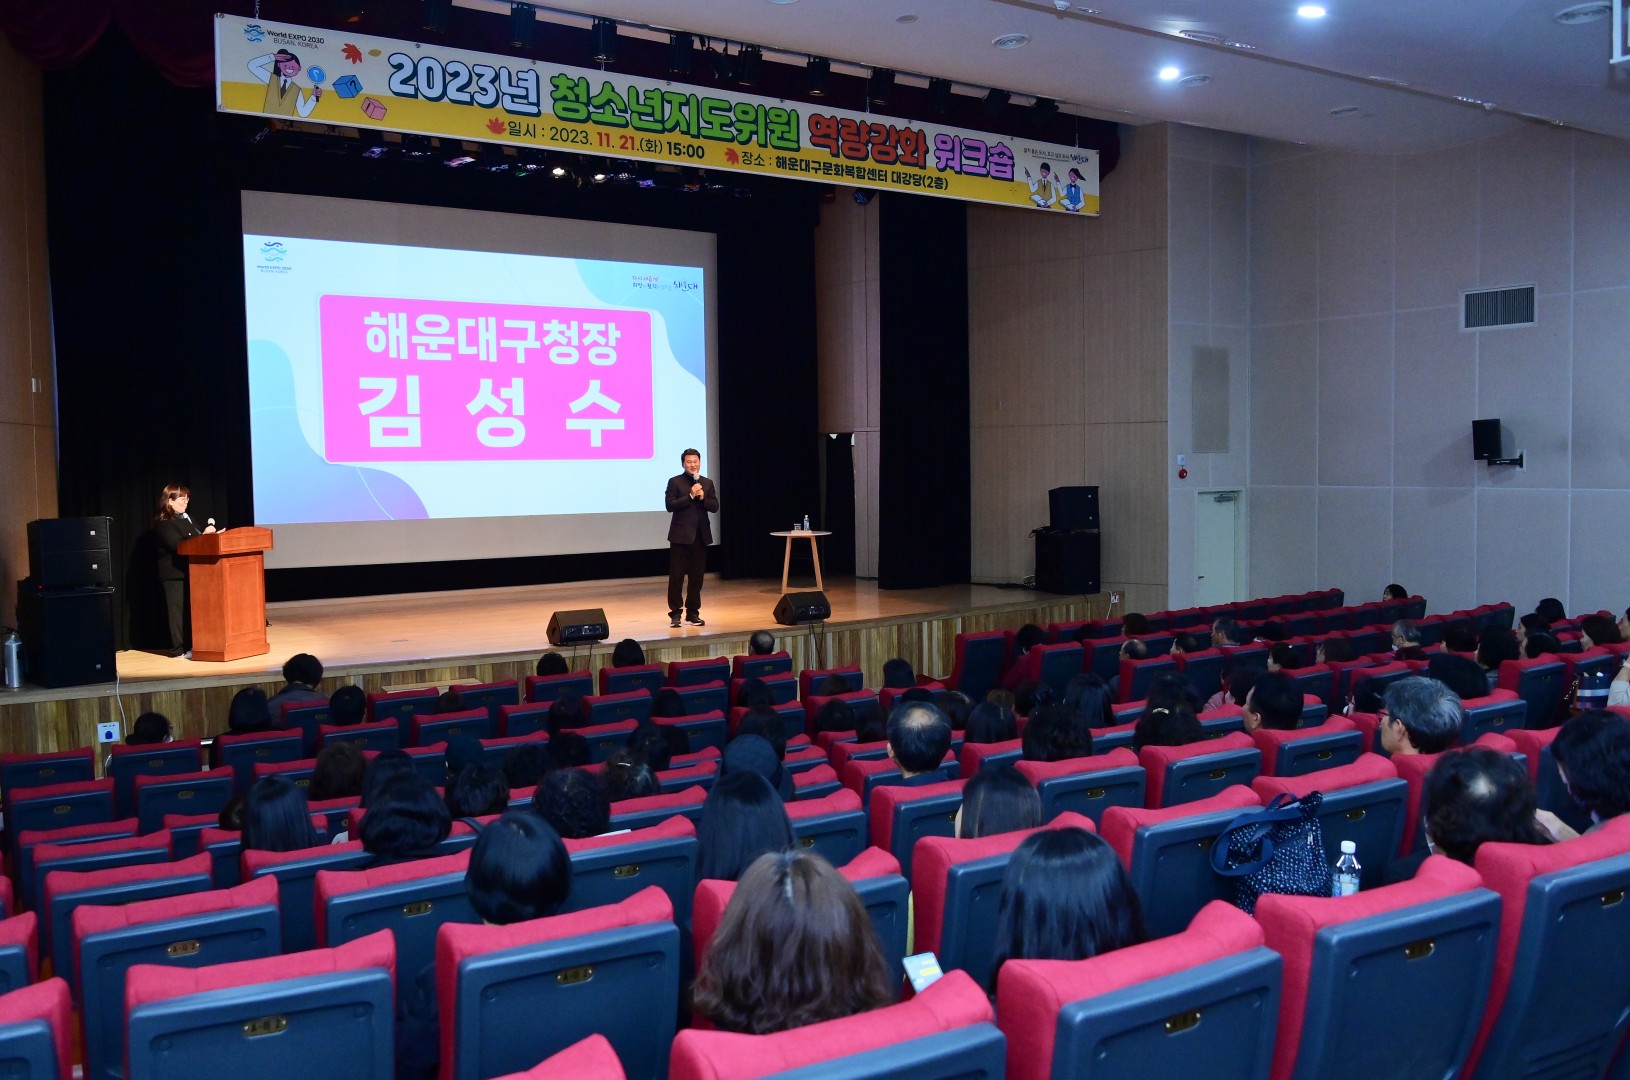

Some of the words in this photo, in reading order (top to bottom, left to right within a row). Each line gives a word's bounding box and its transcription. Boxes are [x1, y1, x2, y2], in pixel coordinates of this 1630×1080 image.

[267, 30, 287, 38] World
[288, 33, 306, 41] EXPO
[307, 36, 324, 44] 2030
[298, 41, 318, 49] KOREA
[387, 52, 542, 117] 2023년
[550, 73, 800, 152] 청소년지도위원
[808, 113, 929, 170] 역량강화
[934, 133, 1015, 181] 워크숍
[508, 121, 536, 139] 일시
[550, 126, 593, 146] 2023.
[597, 131, 615, 148] 11.
[619, 134, 663, 155] 21.(화)
[667, 141, 705, 159] 15:00
[741, 149, 766, 167] 장소
[775, 154, 888, 183] 해운대구문화복합센터
[891, 171, 948, 190] 대강당(2층)
[363, 311, 621, 366] 해운대구청장
[357, 374, 422, 448] 김
[465, 377, 526, 448] 성
[565, 379, 625, 447] 수
